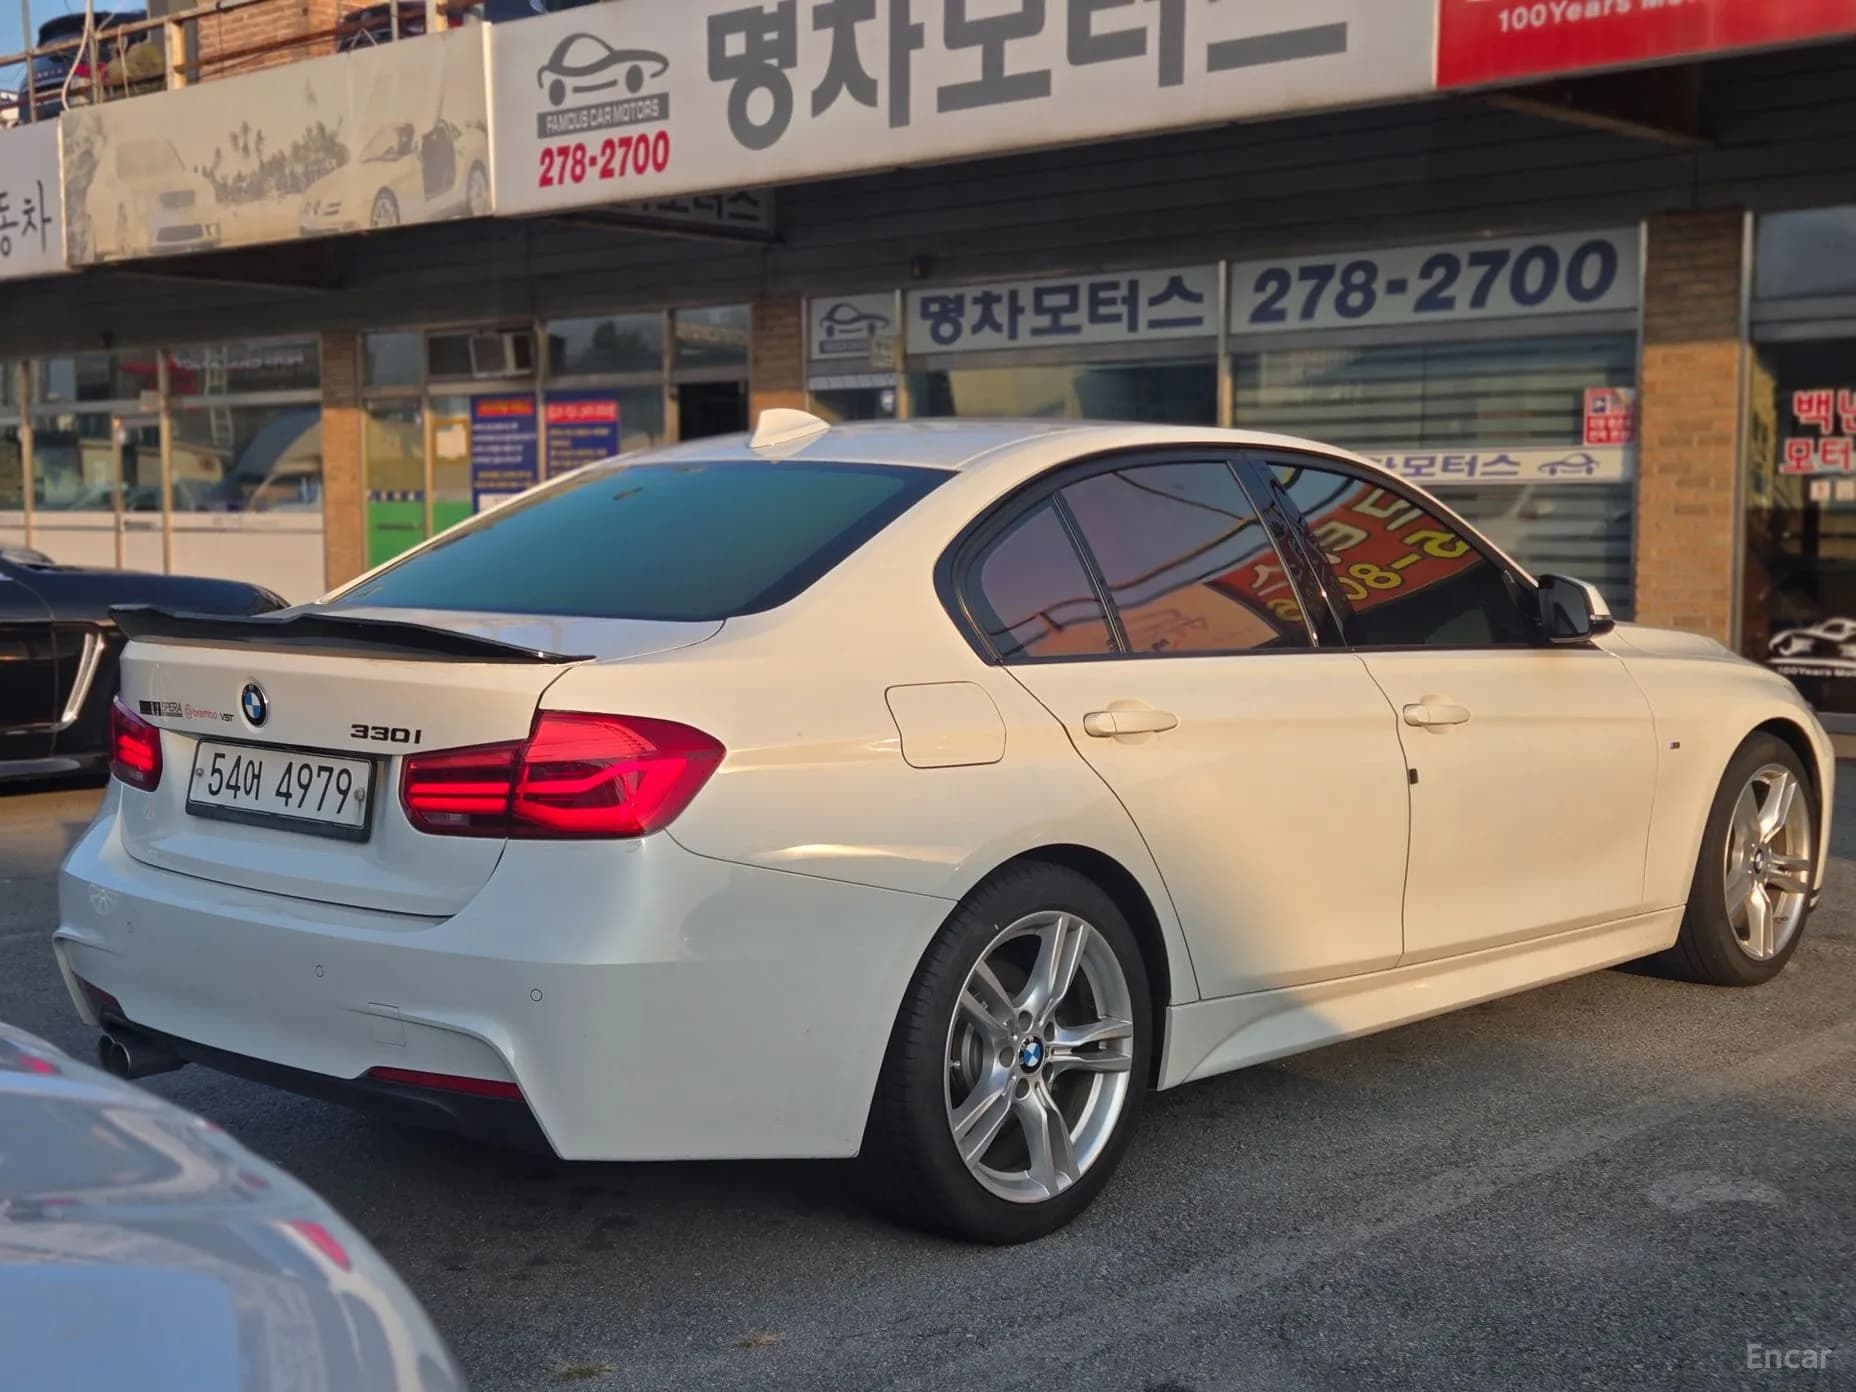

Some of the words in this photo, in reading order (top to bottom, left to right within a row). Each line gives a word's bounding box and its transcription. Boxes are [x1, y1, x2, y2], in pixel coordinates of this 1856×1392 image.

[546, 110, 588, 134] FAMOUS
[589, 104, 612, 126] CAR
[613, 98, 660, 123] MOTORS
[538, 130, 670, 188] 278-2700
[919, 274, 1205, 346] 명차모터스
[1248, 238, 1619, 325] 278-2700
[207, 752, 263, 801] 54어
[275, 760, 353, 815] 4979
